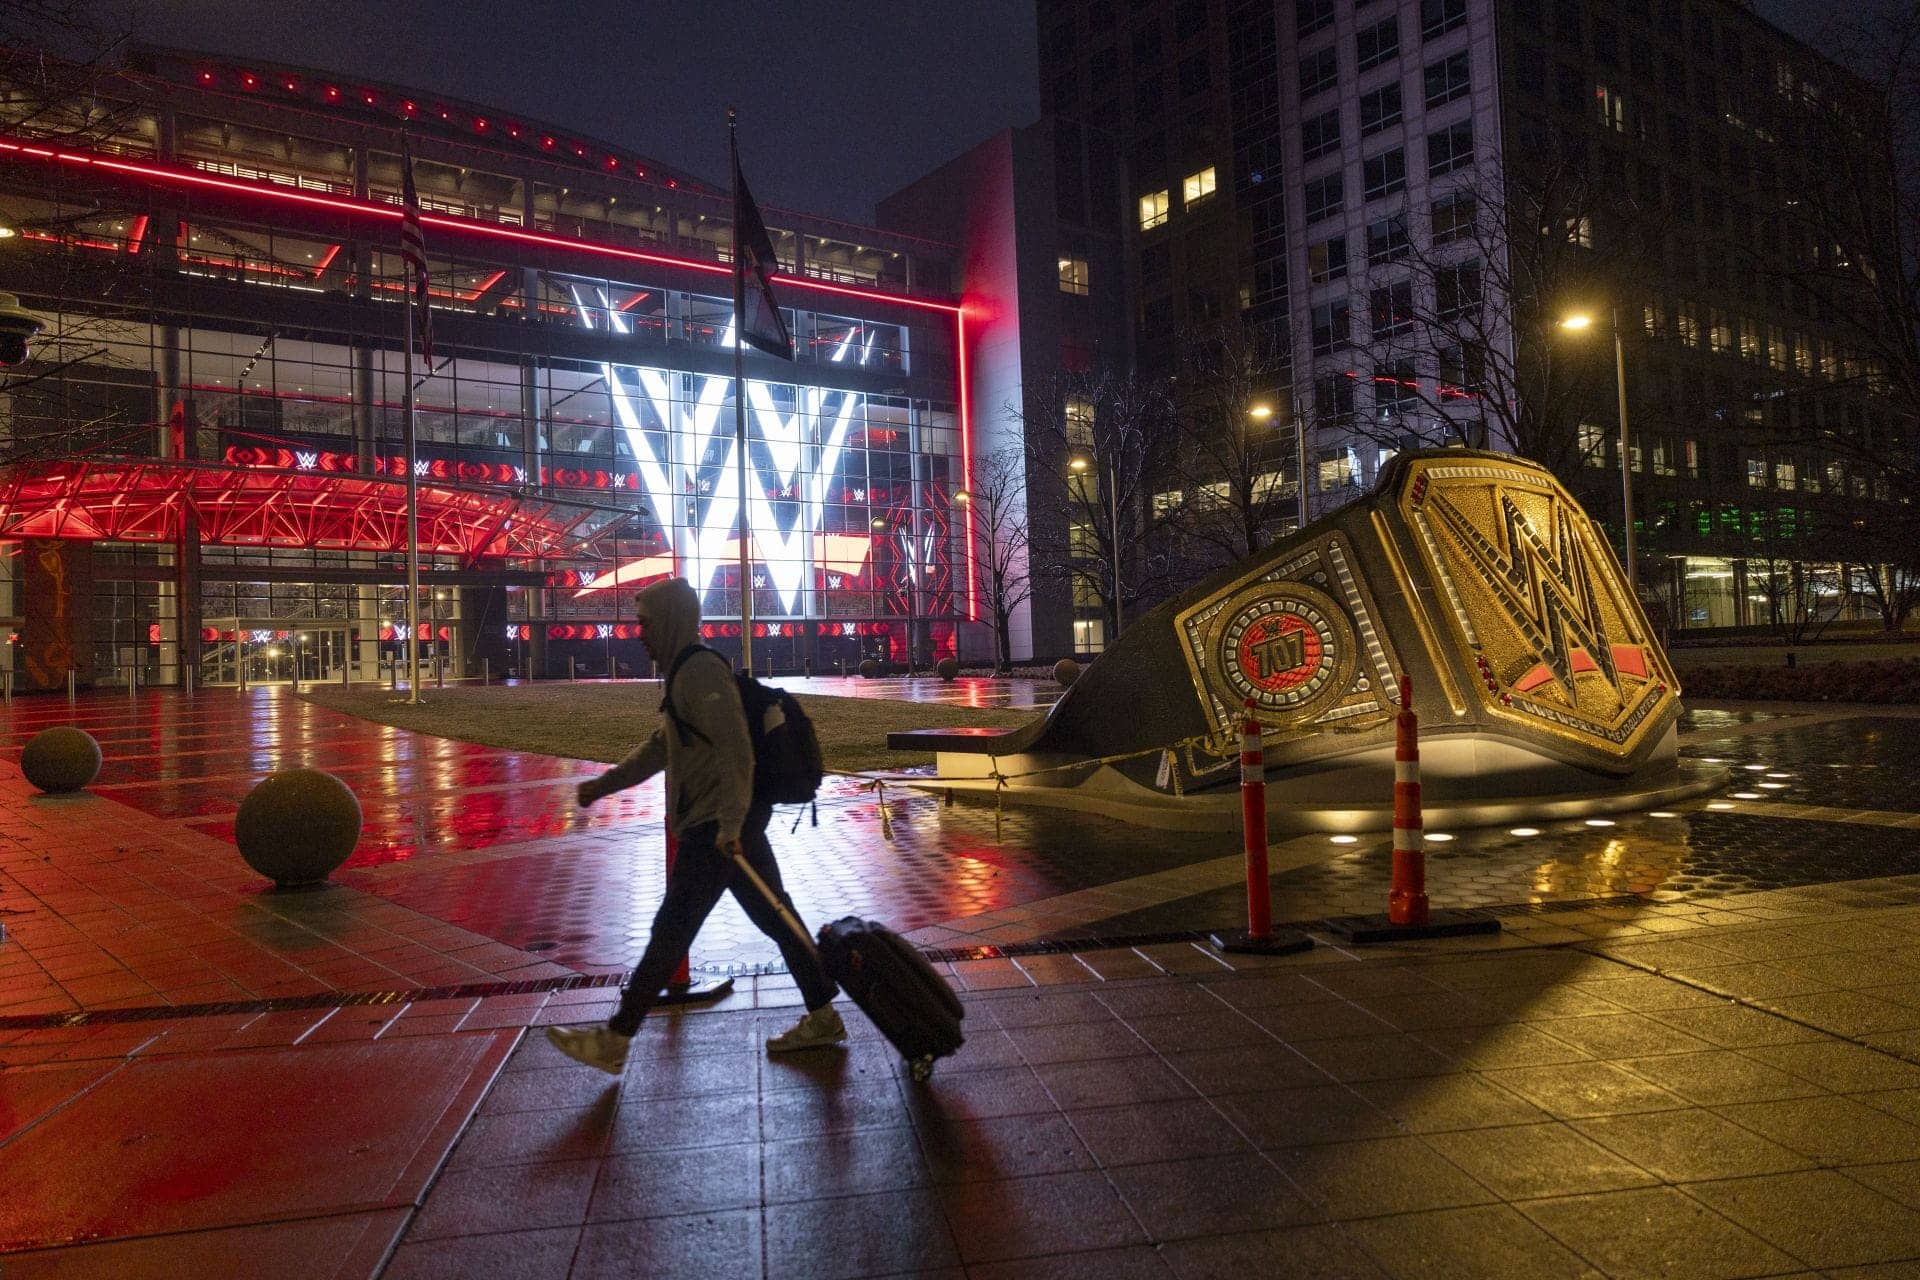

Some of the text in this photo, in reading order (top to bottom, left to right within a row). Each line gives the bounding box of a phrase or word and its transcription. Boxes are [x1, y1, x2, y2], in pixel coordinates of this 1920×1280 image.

[1250, 629, 1305, 679] 707
[1521, 688, 1661, 743] WWE WORLD HEADQUARTERS
